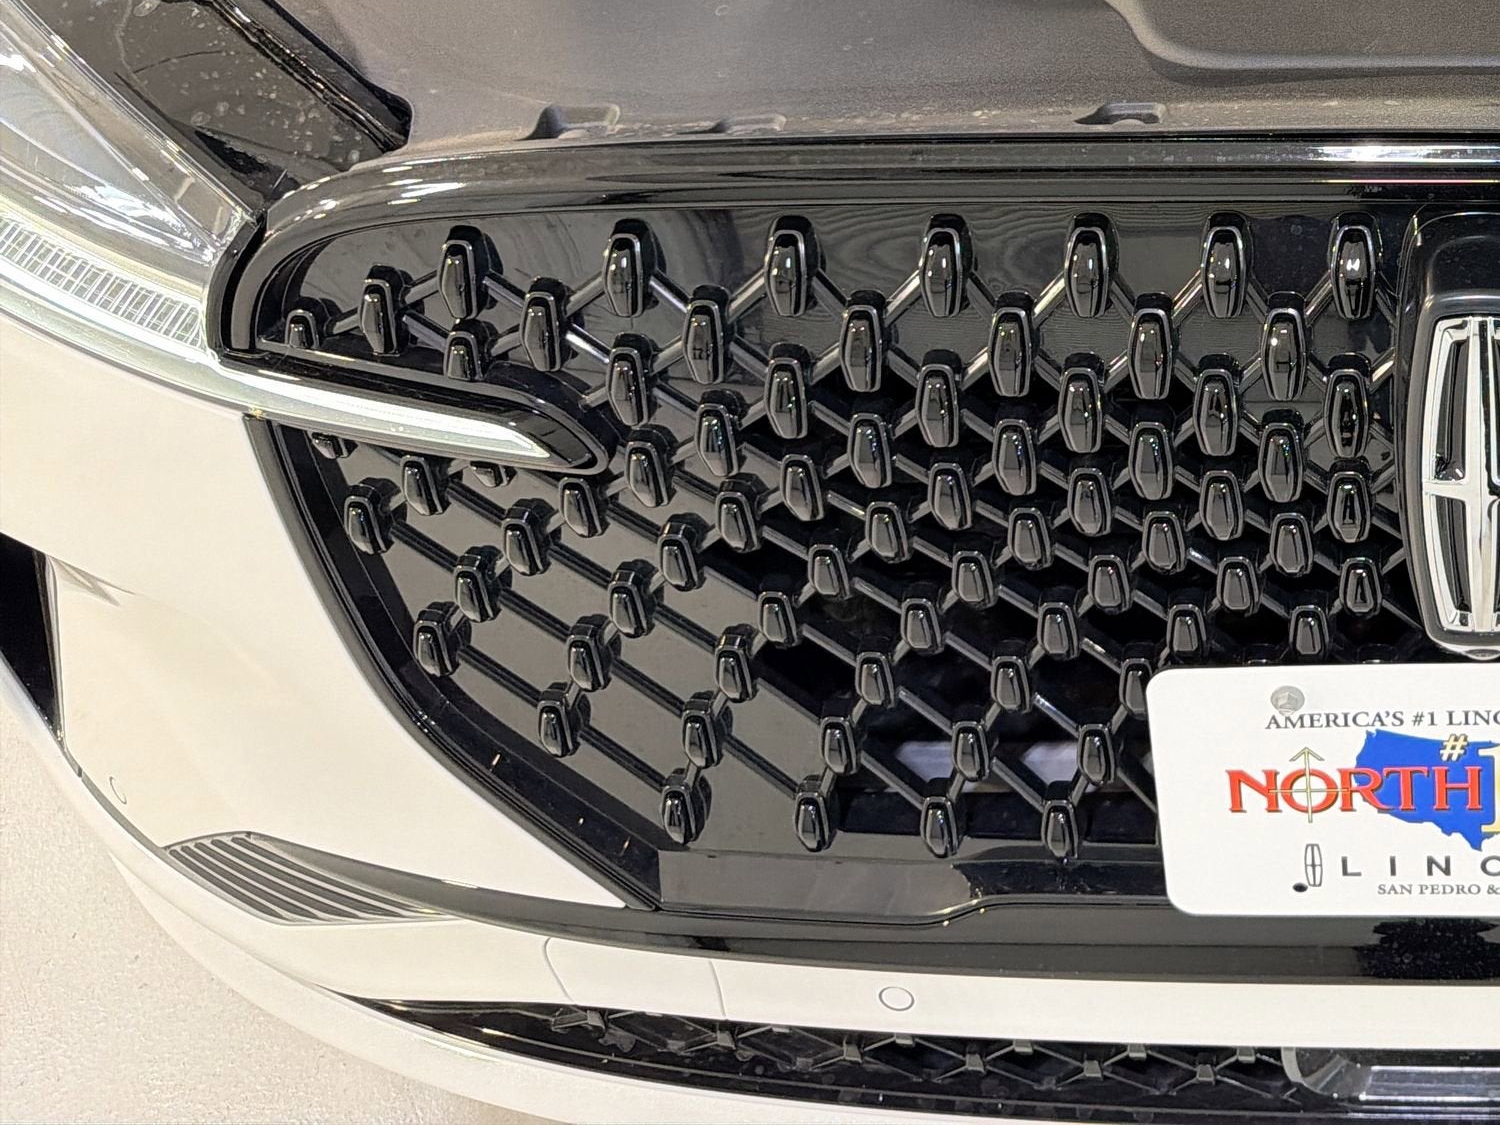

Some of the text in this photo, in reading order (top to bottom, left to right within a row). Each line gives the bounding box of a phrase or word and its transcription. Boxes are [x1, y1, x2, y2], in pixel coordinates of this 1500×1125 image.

[1264, 710, 1404, 729] AMERICA'S
[1412, 711, 1438, 727] #1
[1225, 765, 1483, 814] NORTH
[1377, 883, 1413, 895] SAN
[1418, 883, 1481, 895] PEDRO
